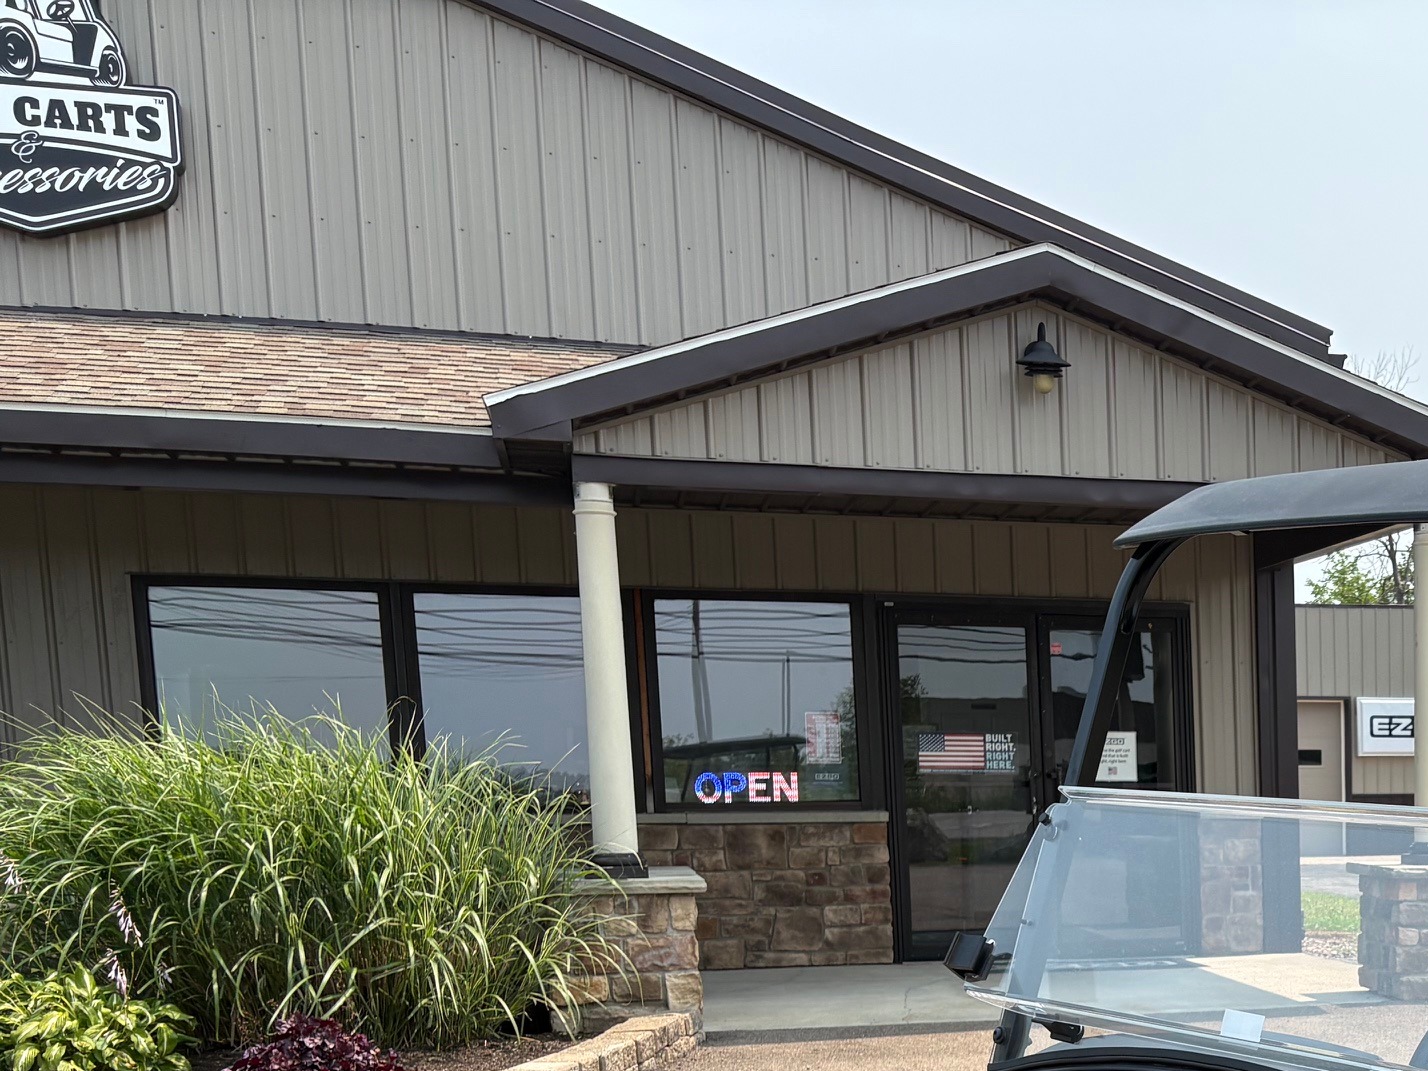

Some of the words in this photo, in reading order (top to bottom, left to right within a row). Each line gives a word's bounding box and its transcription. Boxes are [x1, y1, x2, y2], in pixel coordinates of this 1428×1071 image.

[13, 96, 162, 142] CARTS
[0, 158, 168, 194] essories
[985, 733, 1013, 743] BUILT
[986, 751, 1015, 761] RIGHT
[694, 771, 799, 804] OPEN
